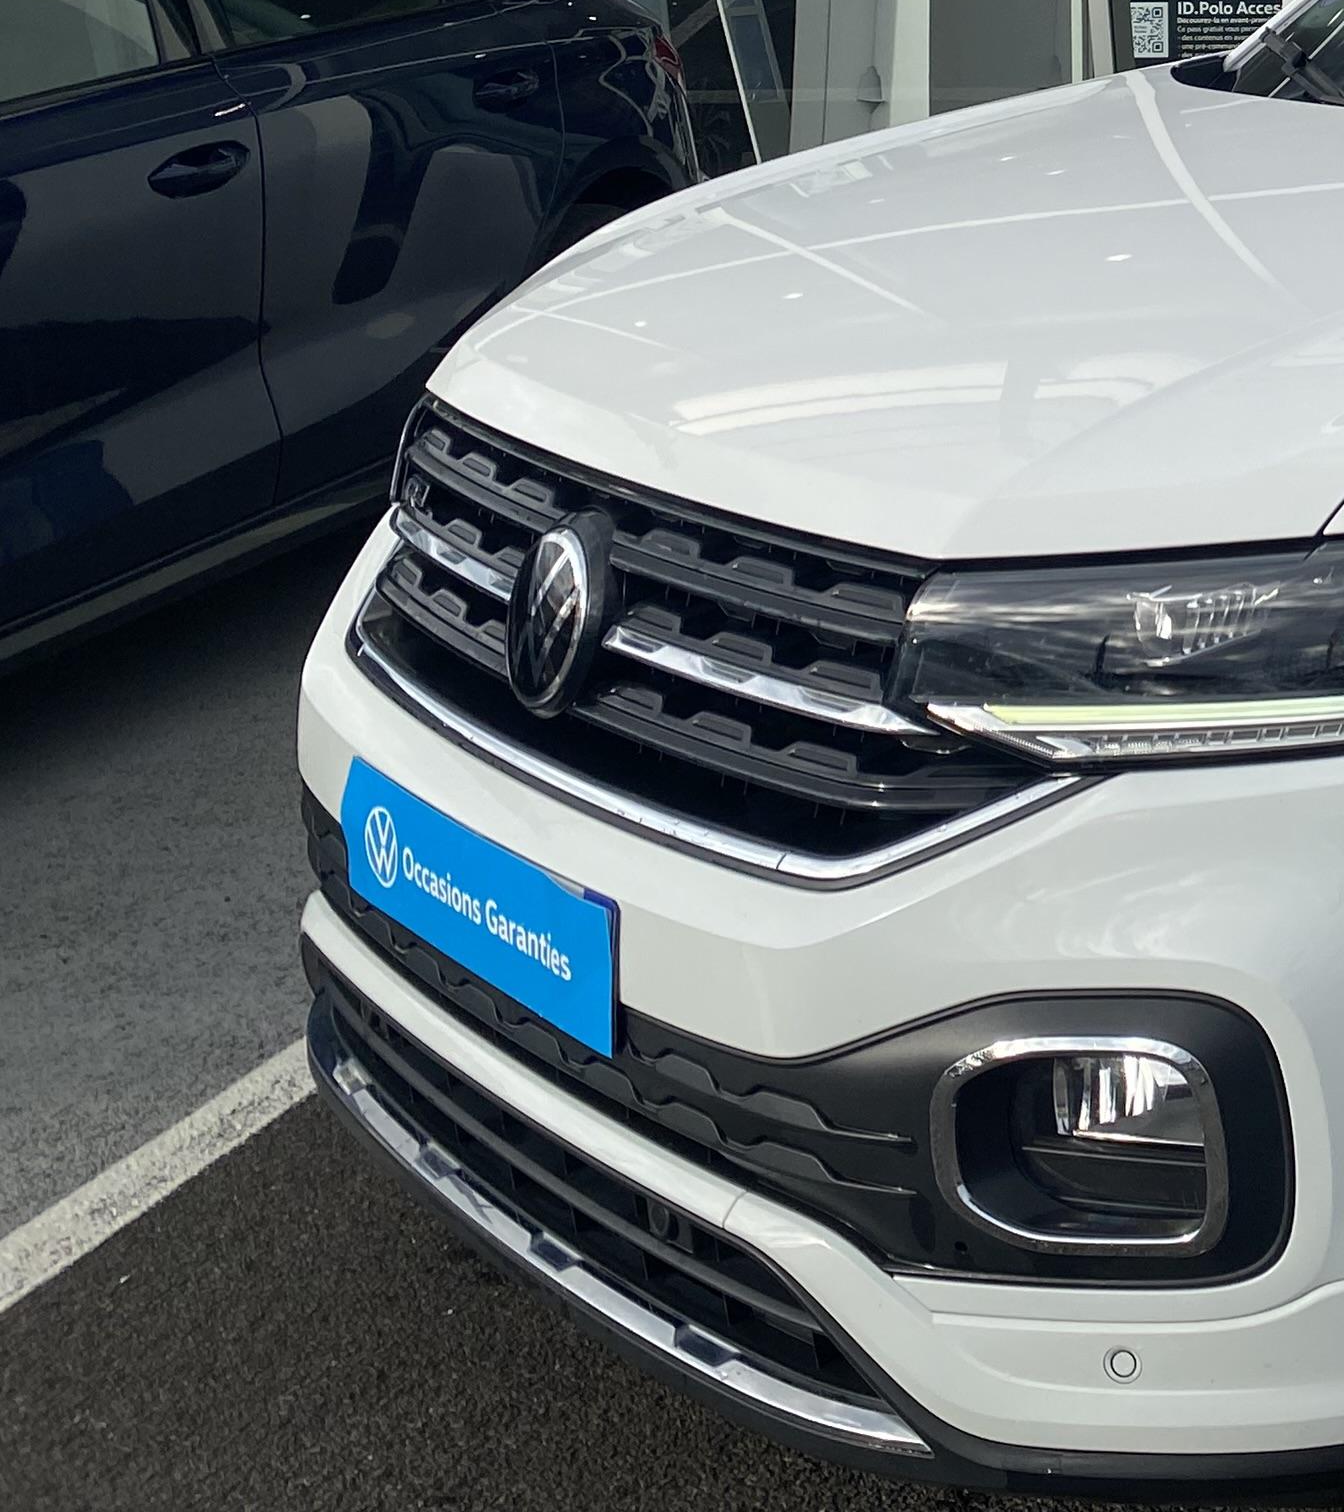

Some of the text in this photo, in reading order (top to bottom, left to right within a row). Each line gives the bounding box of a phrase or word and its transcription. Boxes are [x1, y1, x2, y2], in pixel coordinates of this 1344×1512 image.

[1177, 1, 1281, 15] ID.Polo Acces
[365, 806, 572, 982] VW Occasions Garanties
